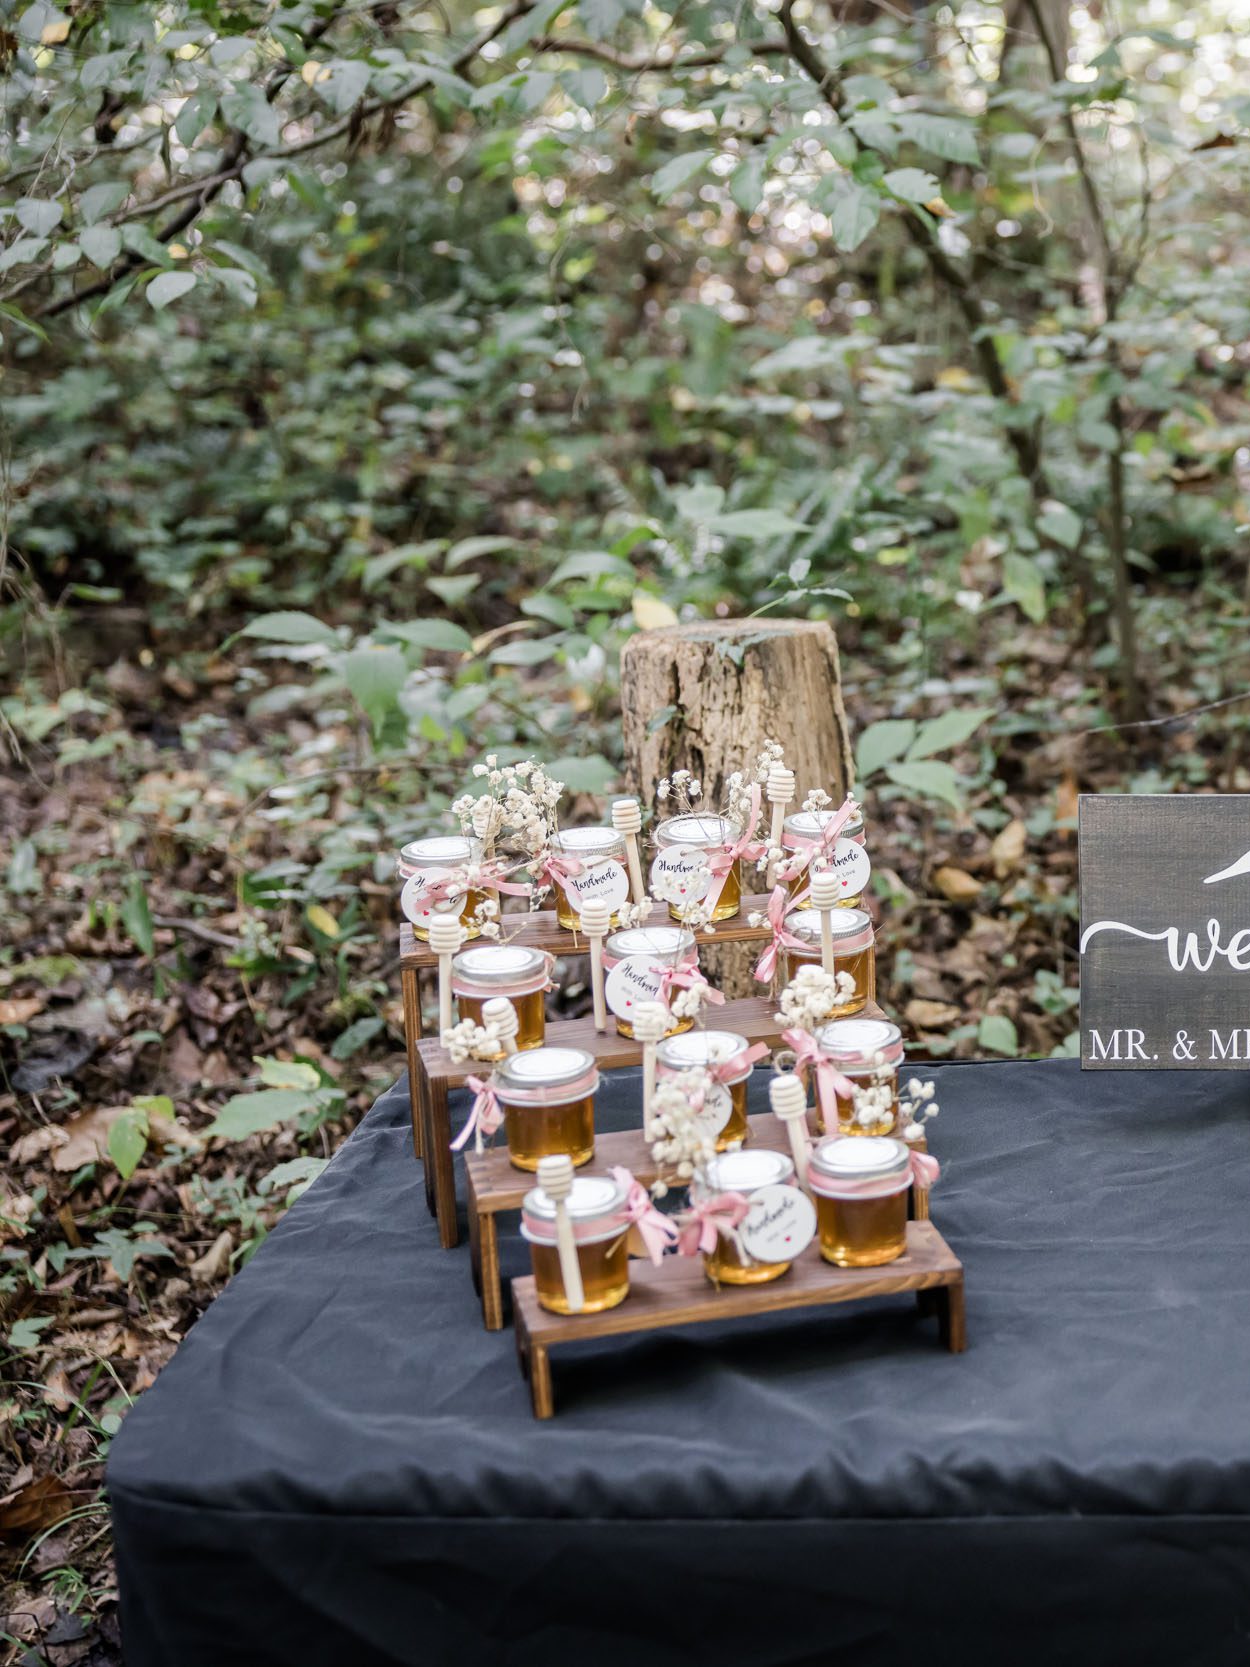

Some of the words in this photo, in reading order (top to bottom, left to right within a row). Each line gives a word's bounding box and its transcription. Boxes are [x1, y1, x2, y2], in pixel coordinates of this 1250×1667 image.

[571, 867, 618, 892] Handmade
[1089, 1029, 1159, 1061] MR.
[1172, 1029, 1198, 1061] &
